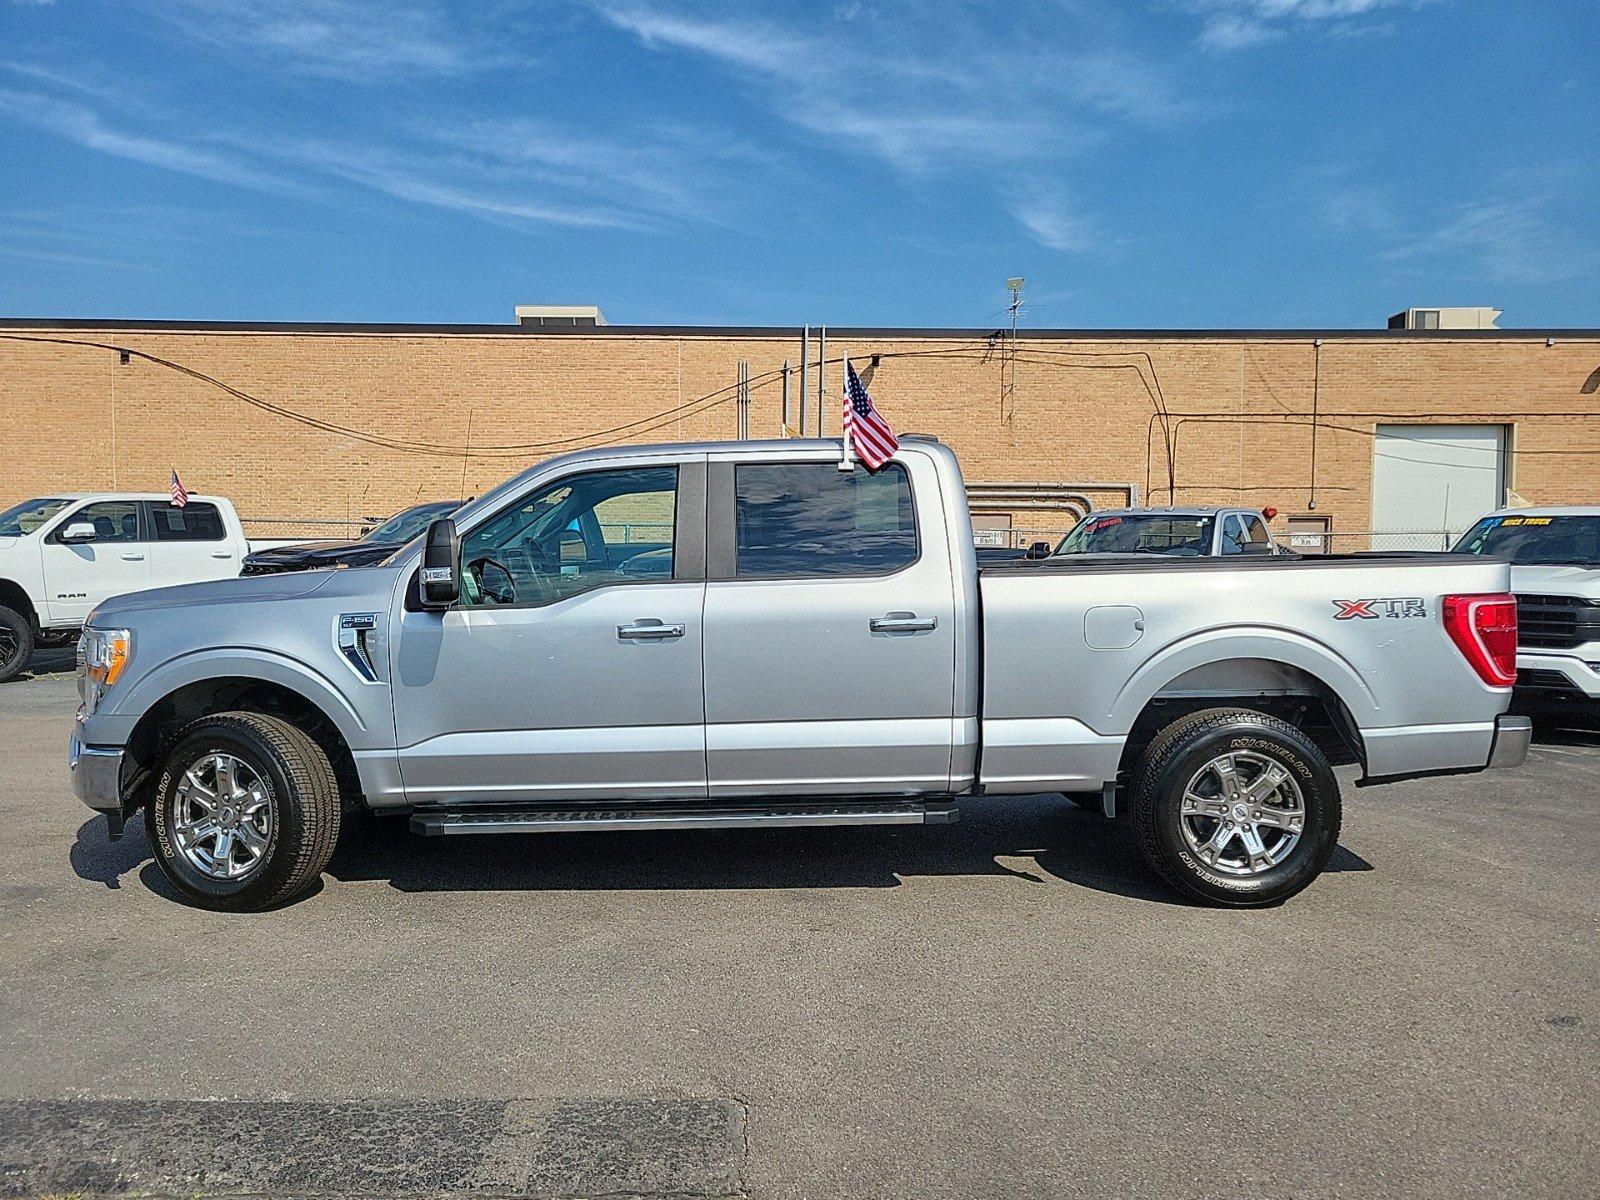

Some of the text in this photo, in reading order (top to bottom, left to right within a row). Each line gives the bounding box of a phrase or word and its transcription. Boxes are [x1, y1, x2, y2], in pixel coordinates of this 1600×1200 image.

[1523, 518, 1553, 526] TRUCK
[1331, 597, 1427, 620] XTR
[1230, 738, 1314, 779] MICHELIN
[155, 771, 175, 859] MICHELIN
